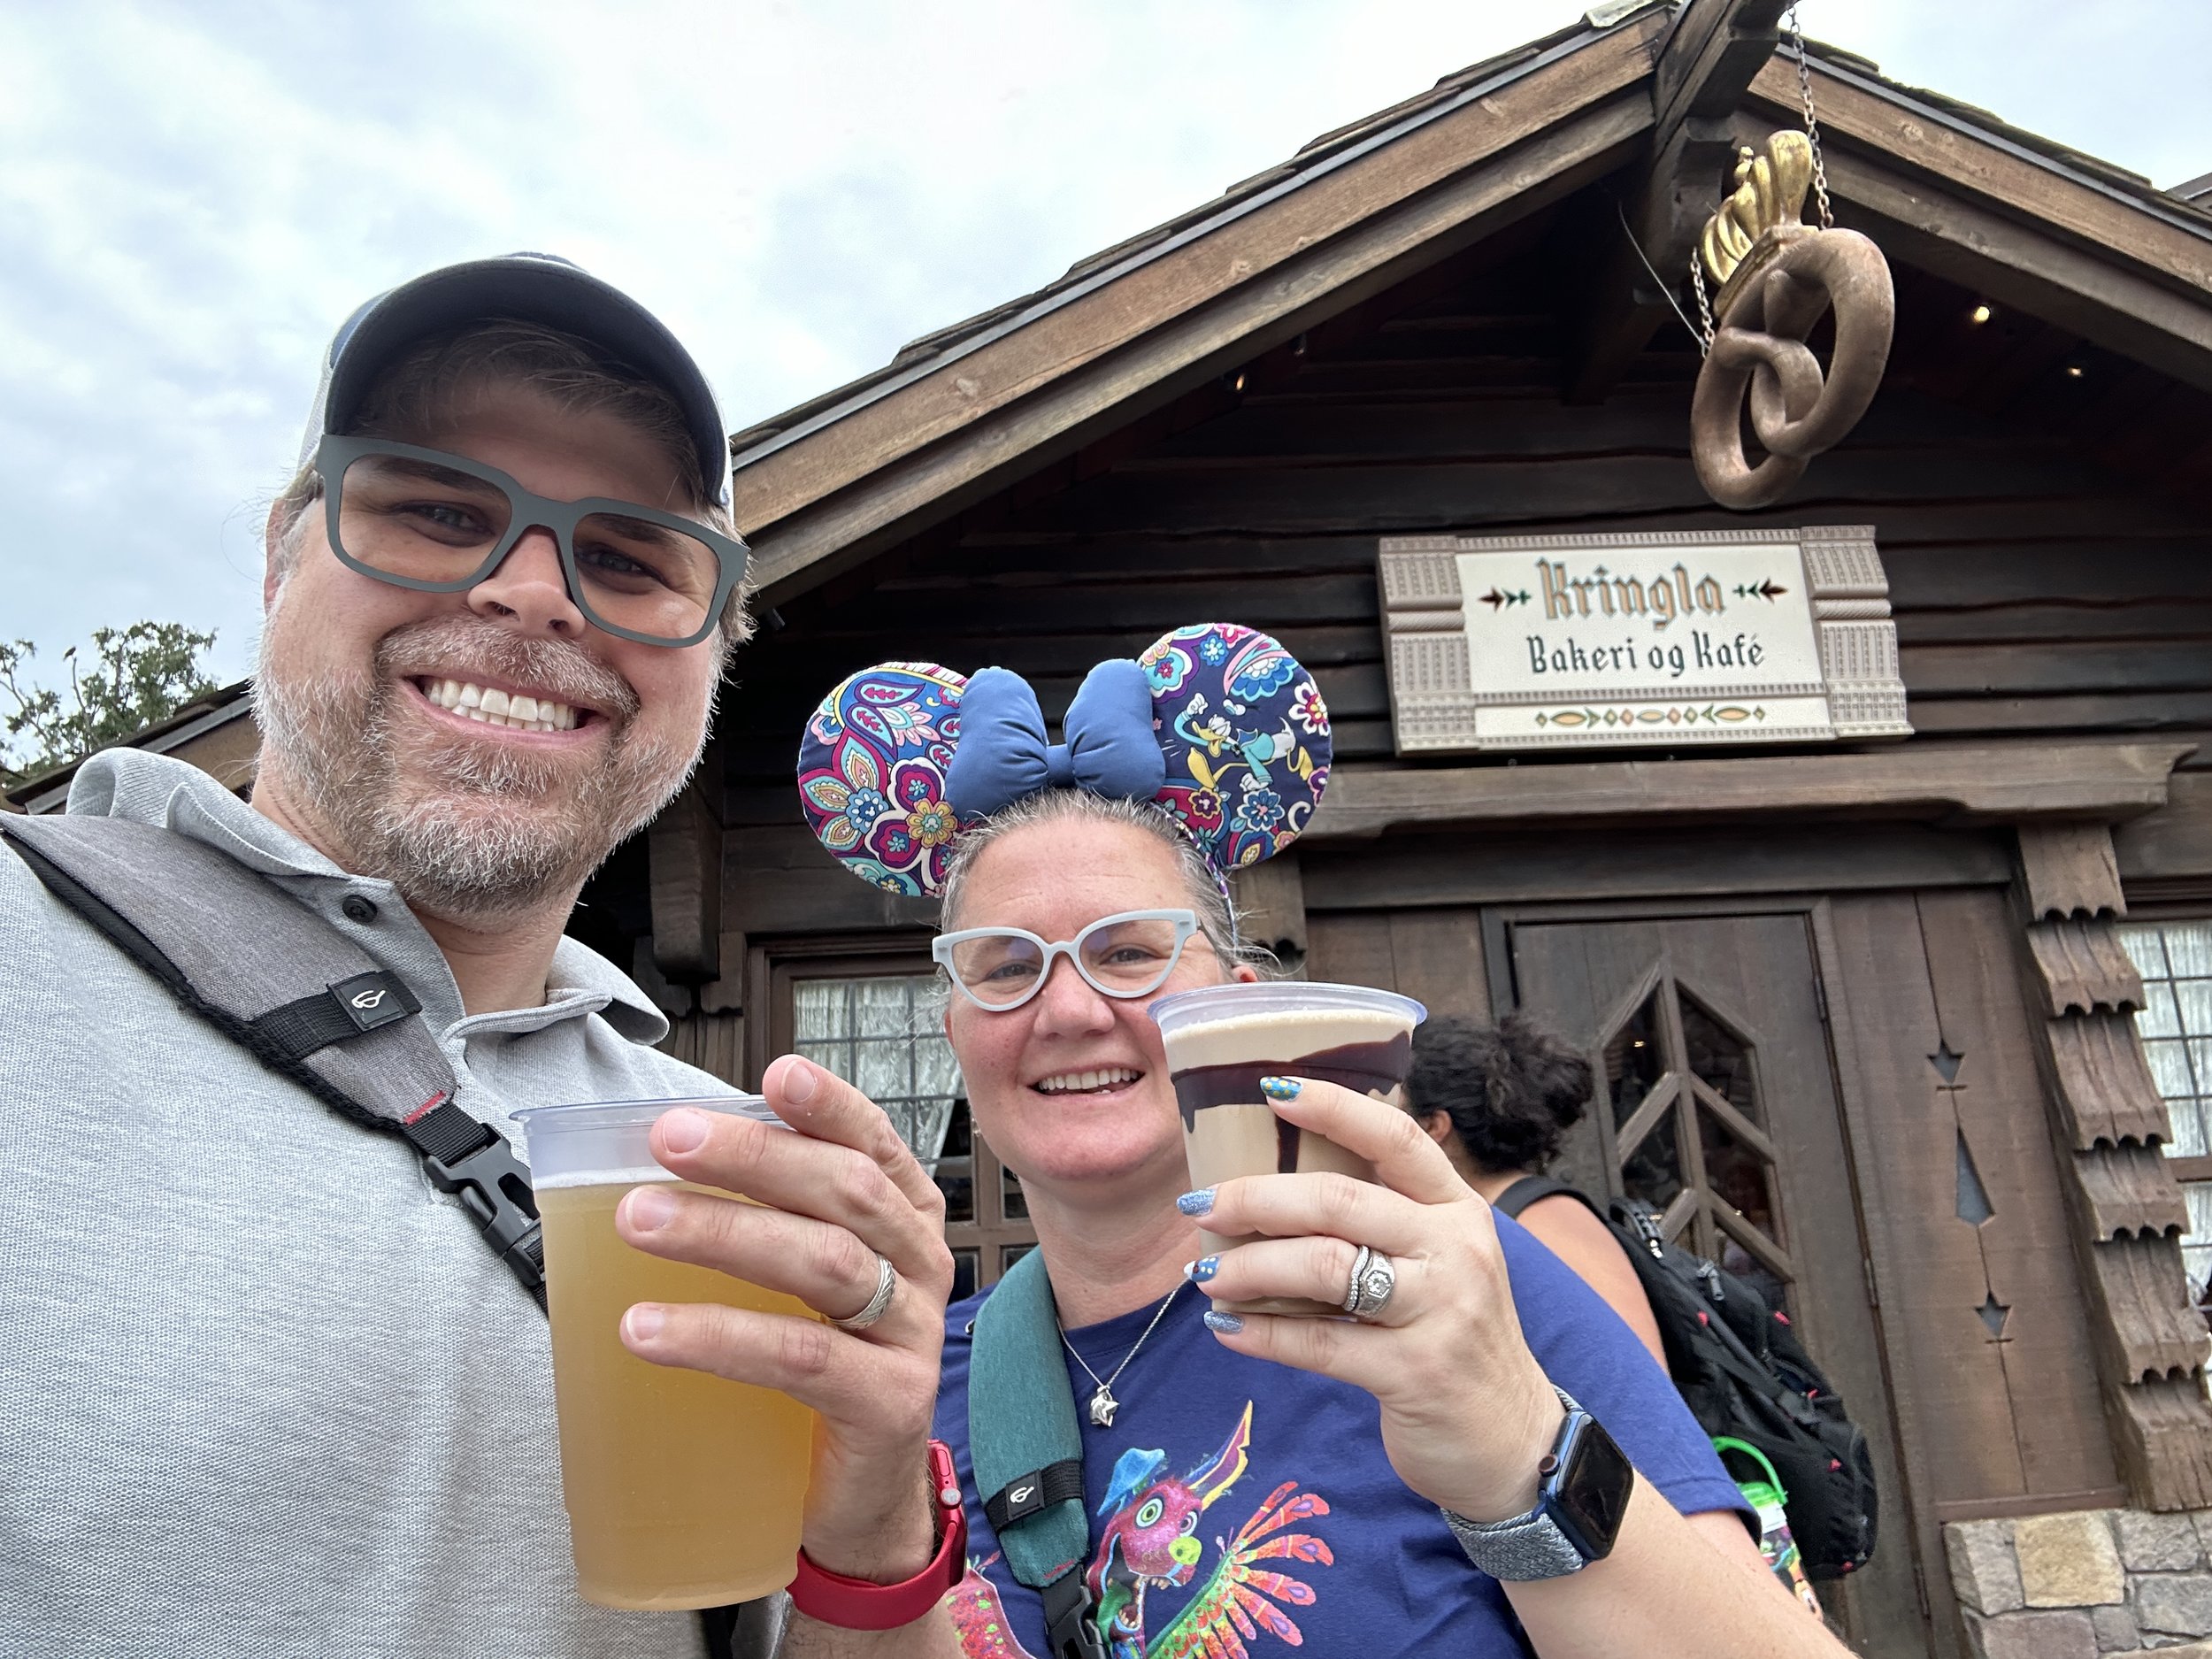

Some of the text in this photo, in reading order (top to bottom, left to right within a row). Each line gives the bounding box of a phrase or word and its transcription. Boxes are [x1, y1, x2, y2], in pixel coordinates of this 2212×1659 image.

[1535, 557, 1726, 631] Kringla
[1526, 630, 1765, 678] Bakeri og Kafé
